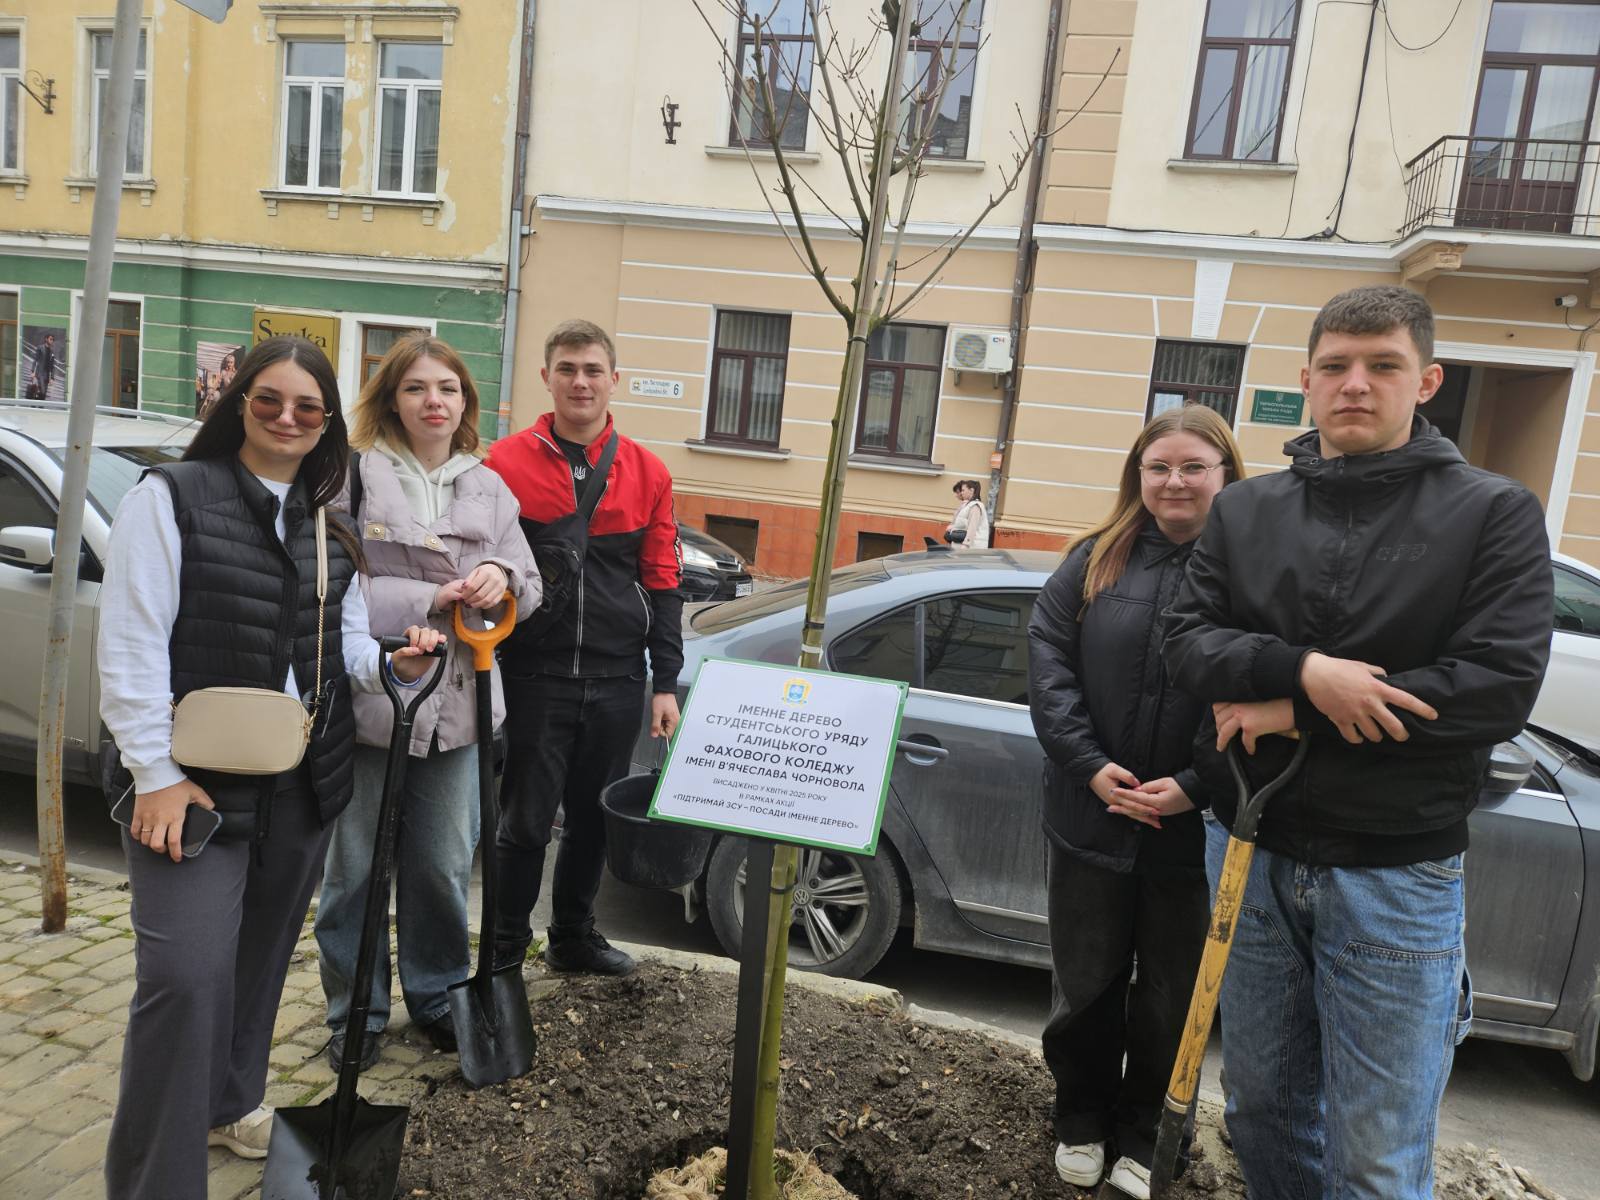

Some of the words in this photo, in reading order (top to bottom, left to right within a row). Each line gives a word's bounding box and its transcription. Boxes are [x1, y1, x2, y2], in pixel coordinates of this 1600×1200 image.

[673, 383, 680, 396] 6
[738, 704, 786, 720] ІМЕННЕ
[789, 711, 842, 728] ДЕРЕВО
[706, 714, 820, 739] СТУДЕНТСЬКОГО
[824, 731, 869, 748] УРЯДУ
[737, 734, 827, 756] ГАЛИЦЬКОГО
[704, 744, 781, 764] ФАХОВОГО
[784, 756, 855, 775] КОЛЕДЖУ
[685, 756, 716, 769] ІМЕНІ
[718, 761, 788, 779] В'ЯЧЕСЛАВА
[791, 772, 865, 792] ЧОРНОВОЛА
[713, 777, 759, 790] ВИСАДЖЕНО
[766, 786, 788, 796] КВІТНІ
[789, 790, 806, 799] 2025
[807, 793, 827, 802] РОКУ
[744, 794, 774, 804] РАМКАХ
[775, 799, 795, 807] АКЦІЇ
[673, 793, 725, 807] «ПІДТРИМАЙ
[726, 801, 743, 810] ЗСУ
[749, 805, 787, 818] ПОСАДИ
[788, 811, 818, 823] ІМЕННЕ
[820, 817, 859, 829] ДЕРЕВО»
